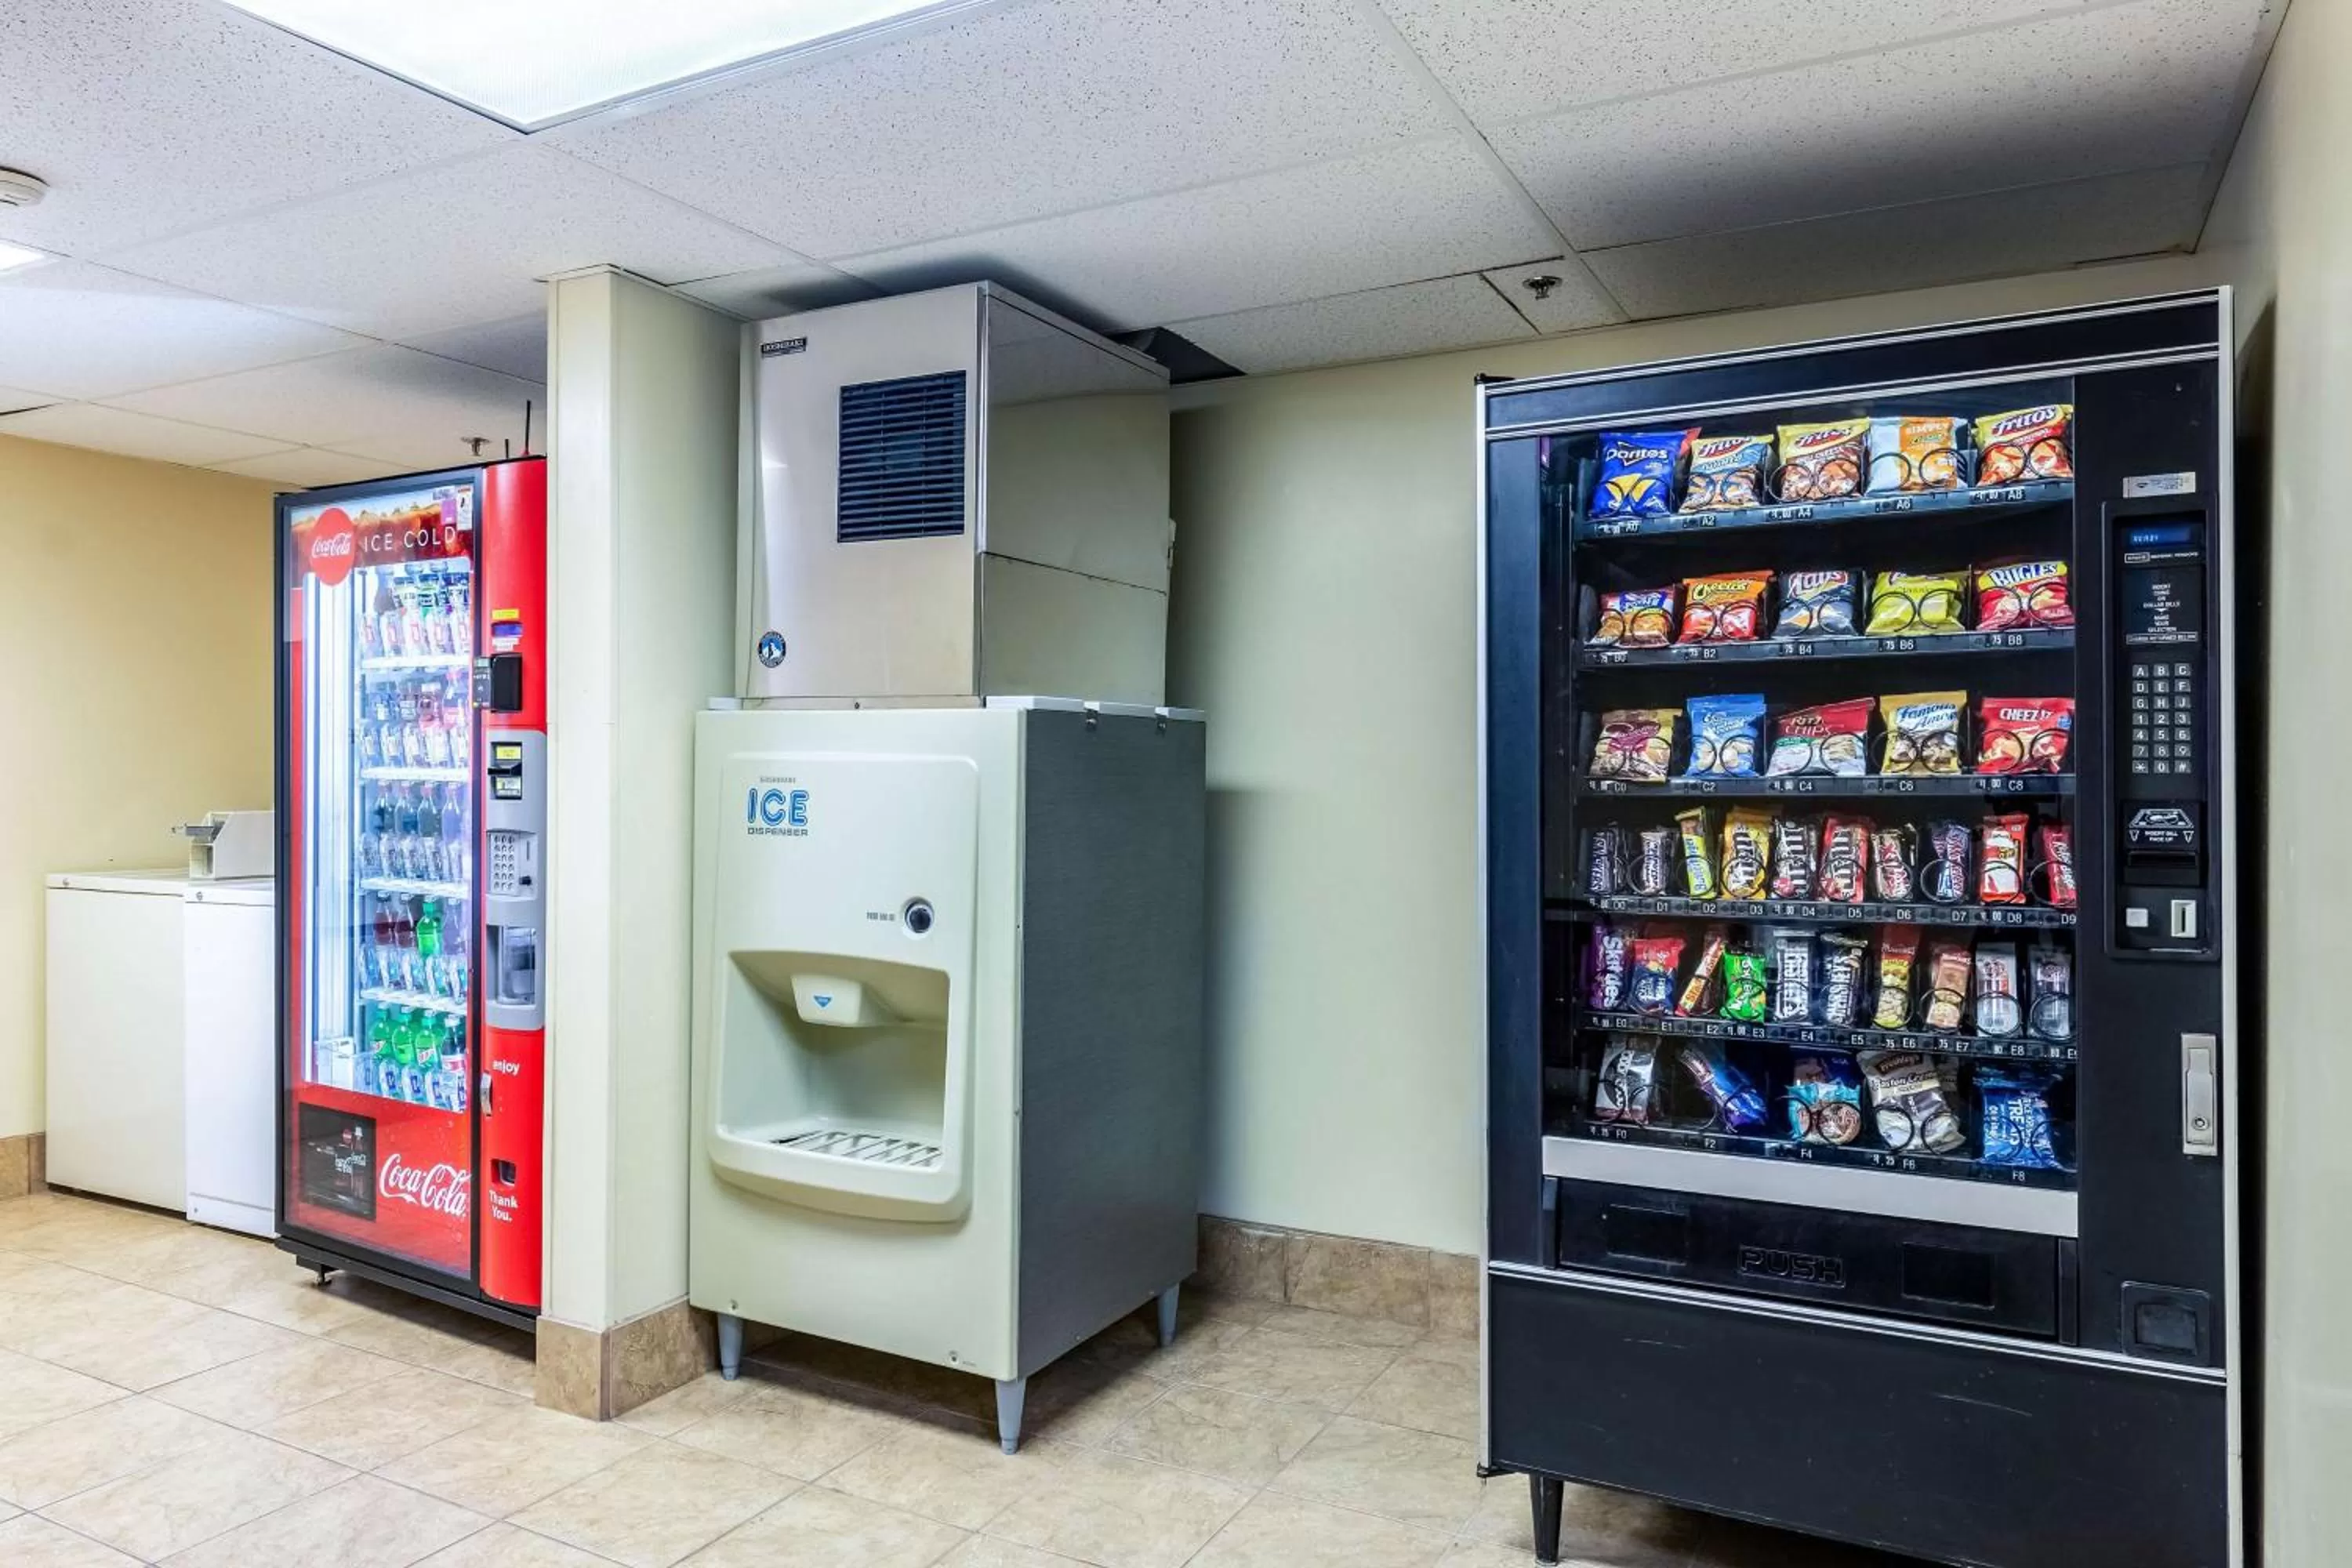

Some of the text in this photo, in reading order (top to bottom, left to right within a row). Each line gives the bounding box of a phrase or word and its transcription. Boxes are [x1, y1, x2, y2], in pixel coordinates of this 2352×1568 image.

[1606, 448, 1668, 462] Doritos
[1896, 499, 1911, 510] A6
[1798, 508, 1812, 518] A4
[1702, 516, 1715, 526] A2
[311, 532, 352, 558] Coca-Cola
[363, 526, 456, 553] ICE COLD
[1900, 639, 1914, 650] B6
[2008, 635, 2022, 645] B8
[1704, 648, 1716, 658] B2
[1799, 644, 1813, 655] B4
[2180, 698, 2186, 706] J
[2139, 715, 2143, 724] 1
[2179, 714, 2186, 723] 3
[2136, 731, 2143, 739] 4
[2179, 730, 2186, 739] 6
[2138, 746, 2186, 755] 7 8 9
[2158, 763, 2165, 771] 0
[1702, 782, 1716, 792] C2
[1799, 782, 1813, 792] C4
[2009, 779, 2024, 791] C8
[747, 788, 809, 826] ICE
[747, 827, 809, 837] DISPENSER
[1657, 902, 1669, 913] D1
[1703, 903, 1717, 913] D2
[1749, 906, 1764, 916] D3
[1802, 907, 1816, 917] D4
[1848, 907, 1862, 919] D5
[1896, 909, 1911, 920] D6
[1951, 911, 1967, 922] D7
[2007, 912, 2023, 924] D8
[2060, 914, 2077, 925] D9
[1661, 1021, 1672, 1031] E1
[1706, 1024, 1719, 1035] E2
[1752, 1027, 1765, 1037] E3
[1801, 1031, 1814, 1042] E4
[1851, 1033, 1864, 1045] E5
[1903, 1037, 1917, 1049] E6
[1955, 1040, 1970, 1052] E7
[2010, 1045, 2025, 1056] E8
[492, 1059, 521, 1076] enjoy
[1704, 1138, 1717, 1149] F2
[1801, 1148, 1813, 1159] F4
[2012, 1169, 2026, 1181] F8
[379, 1154, 473, 1216] Coca-Cola
[489, 1189, 519, 1209] Thank
[1740, 1248, 1845, 1283] PUSH
